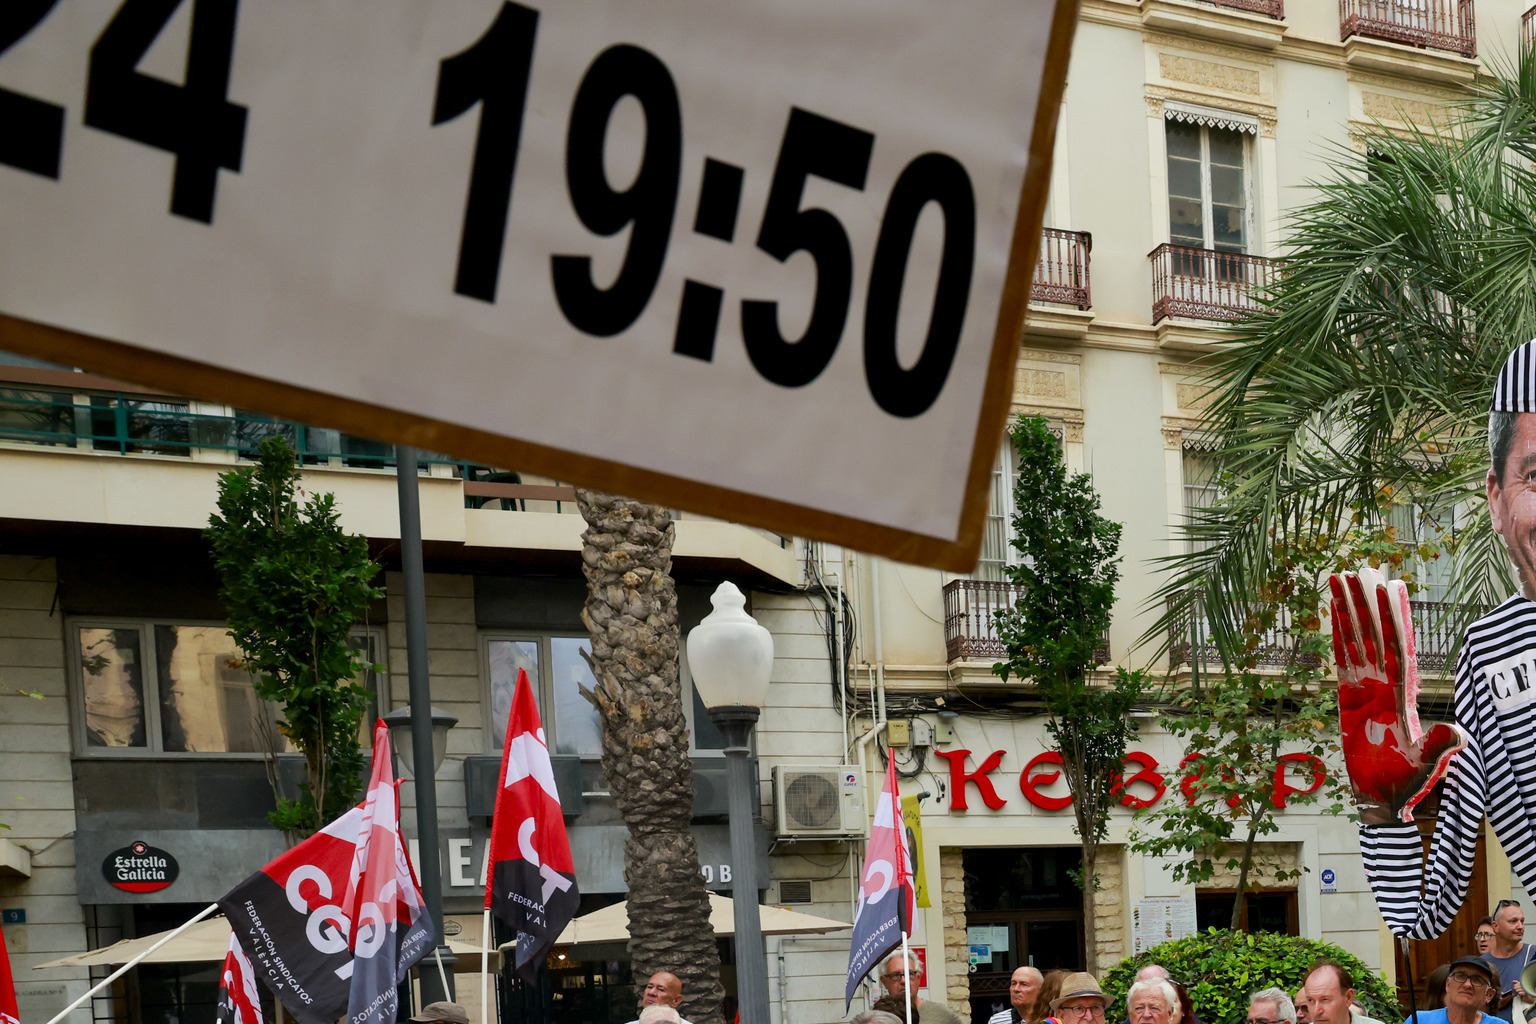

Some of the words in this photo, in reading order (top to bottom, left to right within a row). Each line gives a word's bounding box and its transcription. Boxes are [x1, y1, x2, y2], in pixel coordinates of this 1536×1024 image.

[431, 0, 977, 419] 19:50
[114, 856, 167, 868] Estrella
[117, 868, 165, 880] Galicia
[10, 911, 18, 922] 9
[244, 900, 275, 956] FEDERACIÓN
[273, 952, 314, 1005] SINDICATOS
[249, 927, 284, 990] VALÈNCIA
